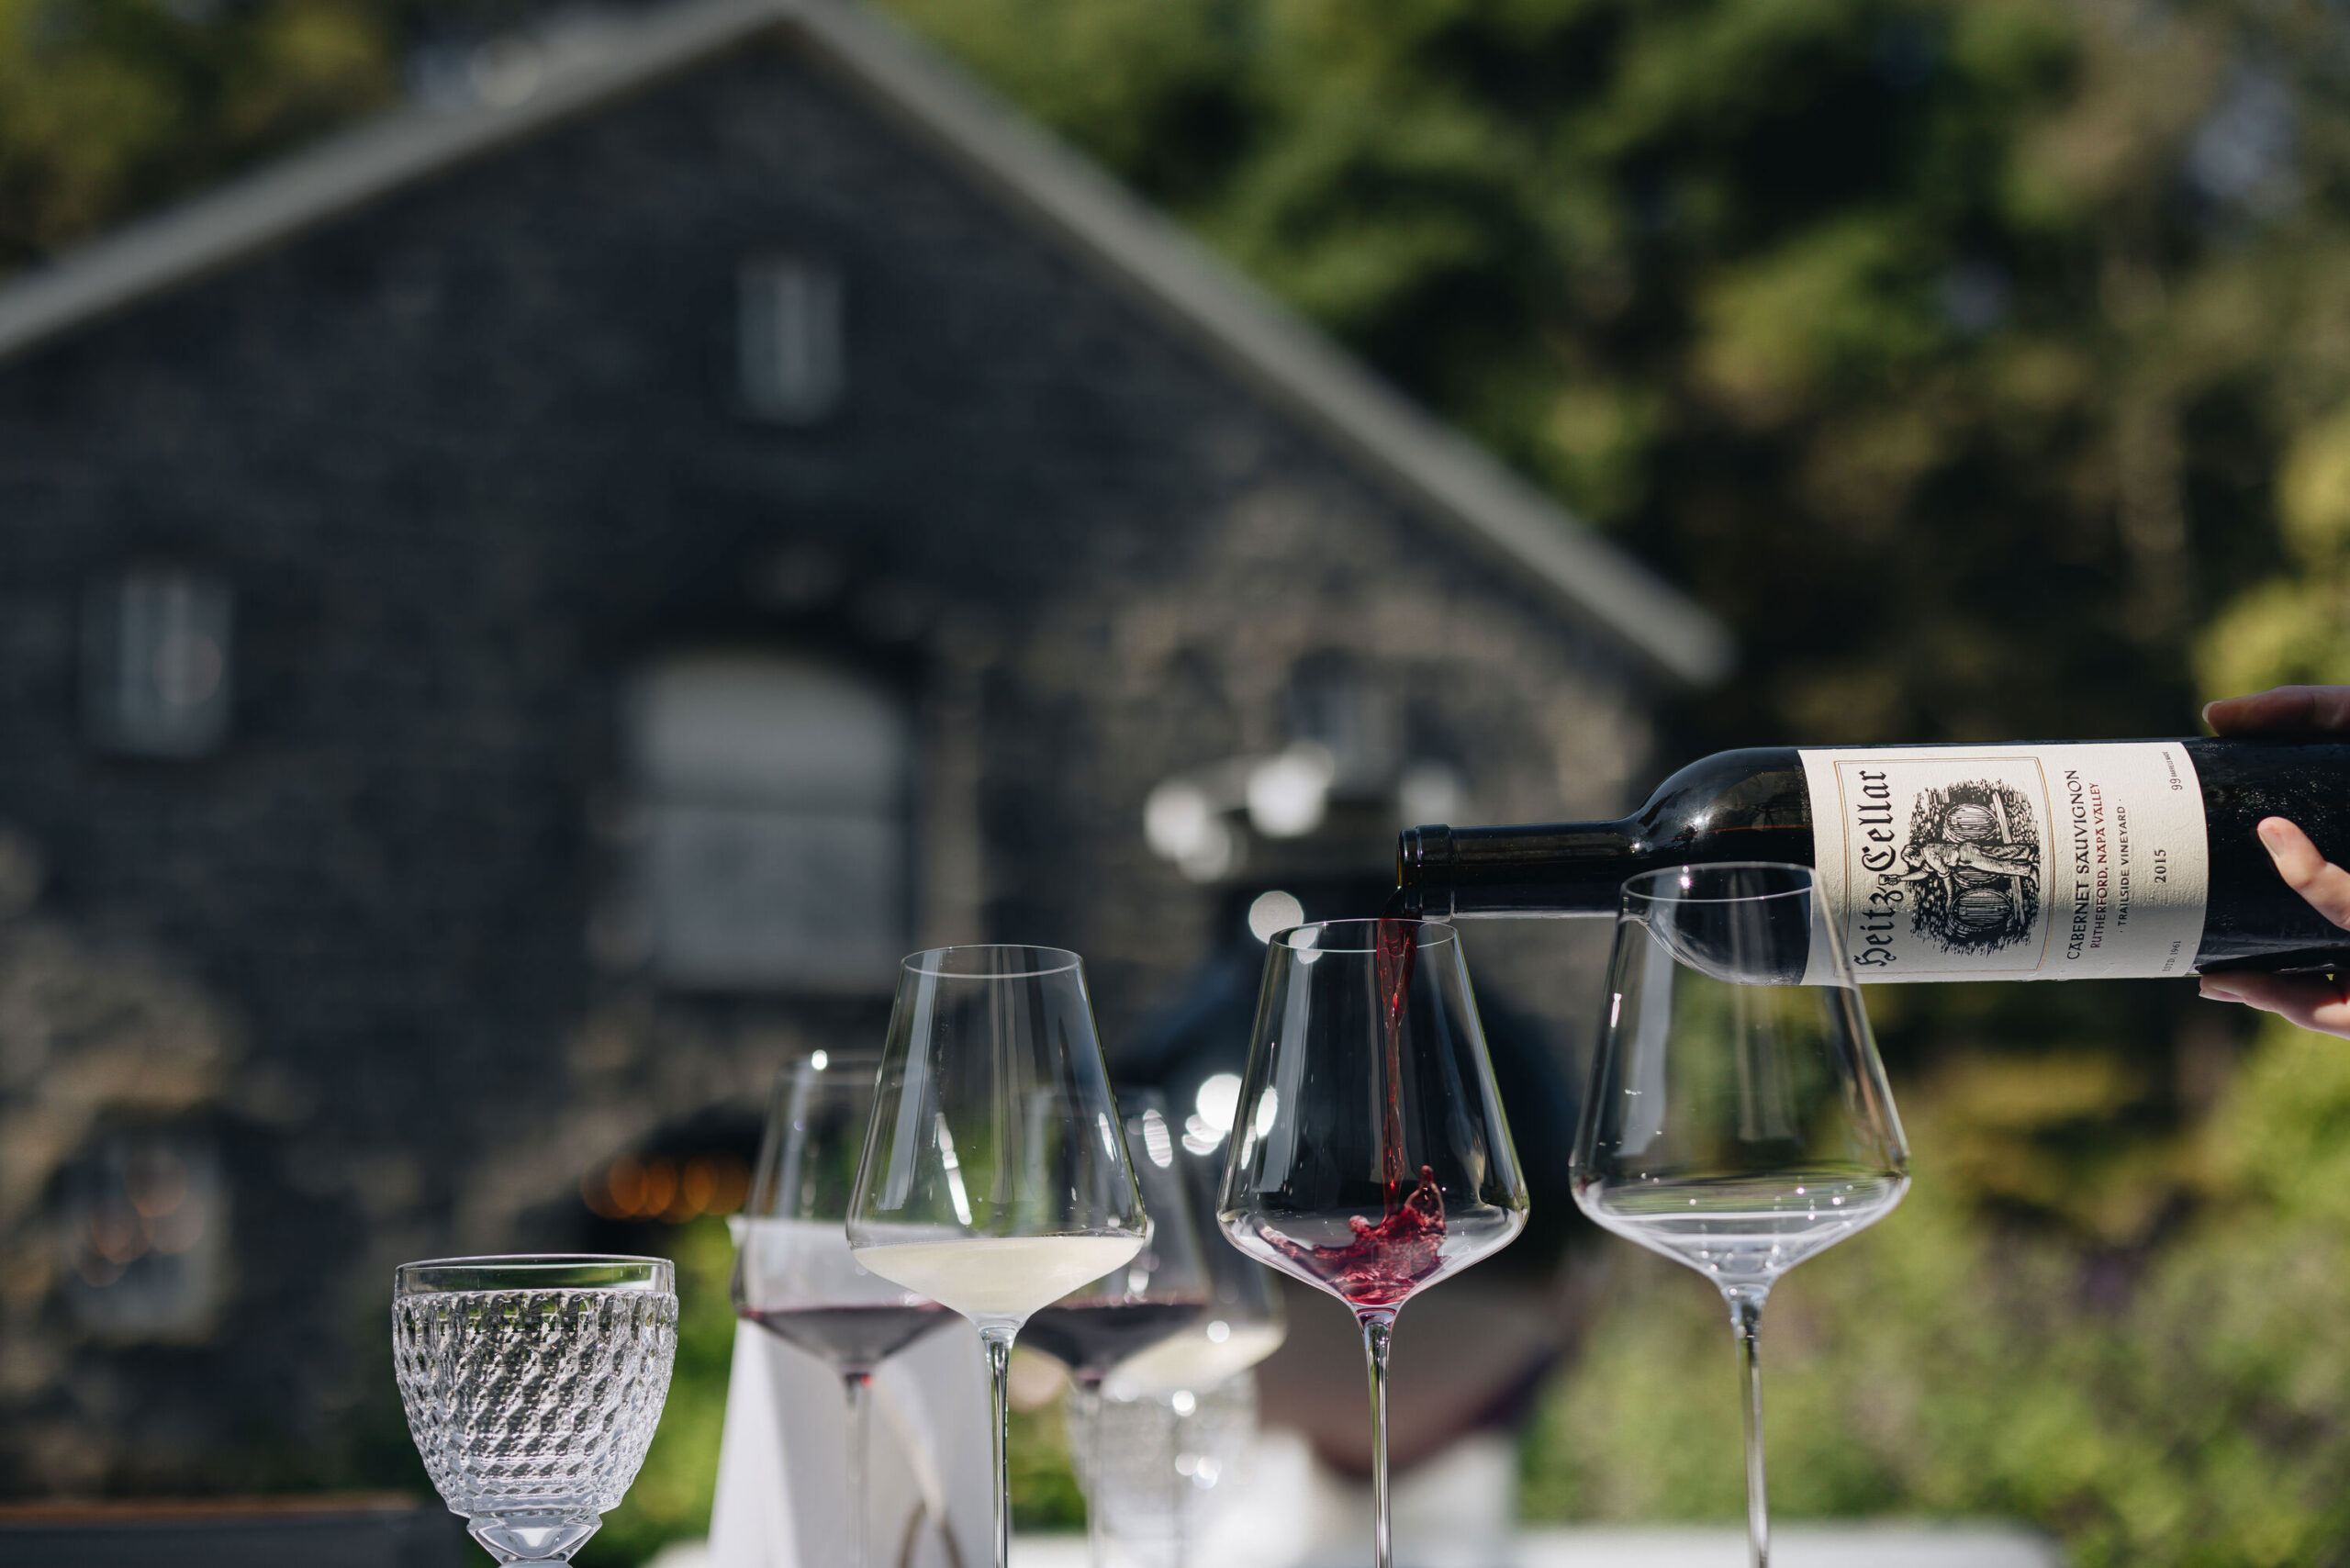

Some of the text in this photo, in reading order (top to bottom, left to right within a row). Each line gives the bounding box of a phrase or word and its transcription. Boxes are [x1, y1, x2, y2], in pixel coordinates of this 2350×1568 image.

[2089, 782, 2104, 825] VALLEY
[2169, 778, 2183, 790] 99
[2065, 770, 2090, 960] CABERNET SAUVIGNON
[2095, 827, 2108, 864] NAPA
[1853, 770, 1904, 967] Heitz Cellar
[2116, 806, 2130, 926] TRAILSIDE VINEYARD
[2154, 849, 2167, 883] 2015
[2169, 941, 2182, 955] 1961
